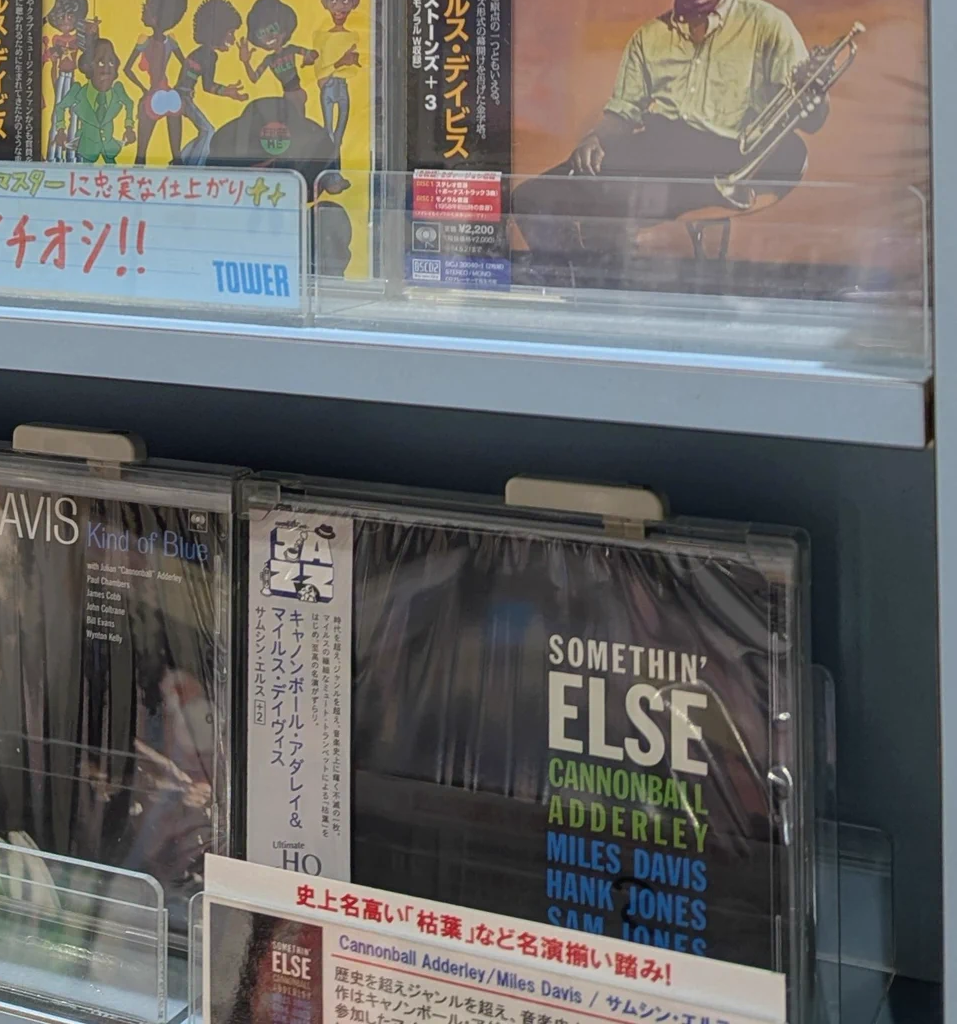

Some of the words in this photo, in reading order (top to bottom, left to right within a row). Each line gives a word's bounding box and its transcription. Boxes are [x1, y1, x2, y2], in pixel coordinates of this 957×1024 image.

[212, 260, 290, 297] TOWER
[86, 522, 130, 554] Kind
[137, 529, 158, 555] of
[163, 530, 209, 562] Blue
[87, 563, 99, 571] with
[157, 571, 182, 584] Adderley
[87, 575, 99, 584] Paul
[101, 577, 130, 589] Chambers
[87, 589, 104, 599] James
[106, 591, 121, 601] Cobb
[87, 603, 99, 612] John
[101, 604, 125, 615] Coltrane
[86, 630, 107, 641] Wynton
[108, 633, 122, 644] Kelly
[87, 616, 96, 624] Bill
[98, 618, 115, 628] Evans
[254, 606, 266, 696] サムシン・エルス
[271, 607, 286, 766] マイルス・デイヴィス
[548, 671, 708, 777] ELSE
[548, 759, 708, 816] CANNONBALL
[273, 840, 304, 850] Ultimate
[548, 801, 708, 853] ADDERLEY
[547, 832, 622, 874] MILES
[633, 848, 707, 892] DAVIS
[546, 869, 614, 911] HANK
[627, 886, 707, 931] JONES
[272, 953, 312, 981] ELSE
[339, 934, 416, 967] Cannonball
[542, 980, 582, 1005] Davis
